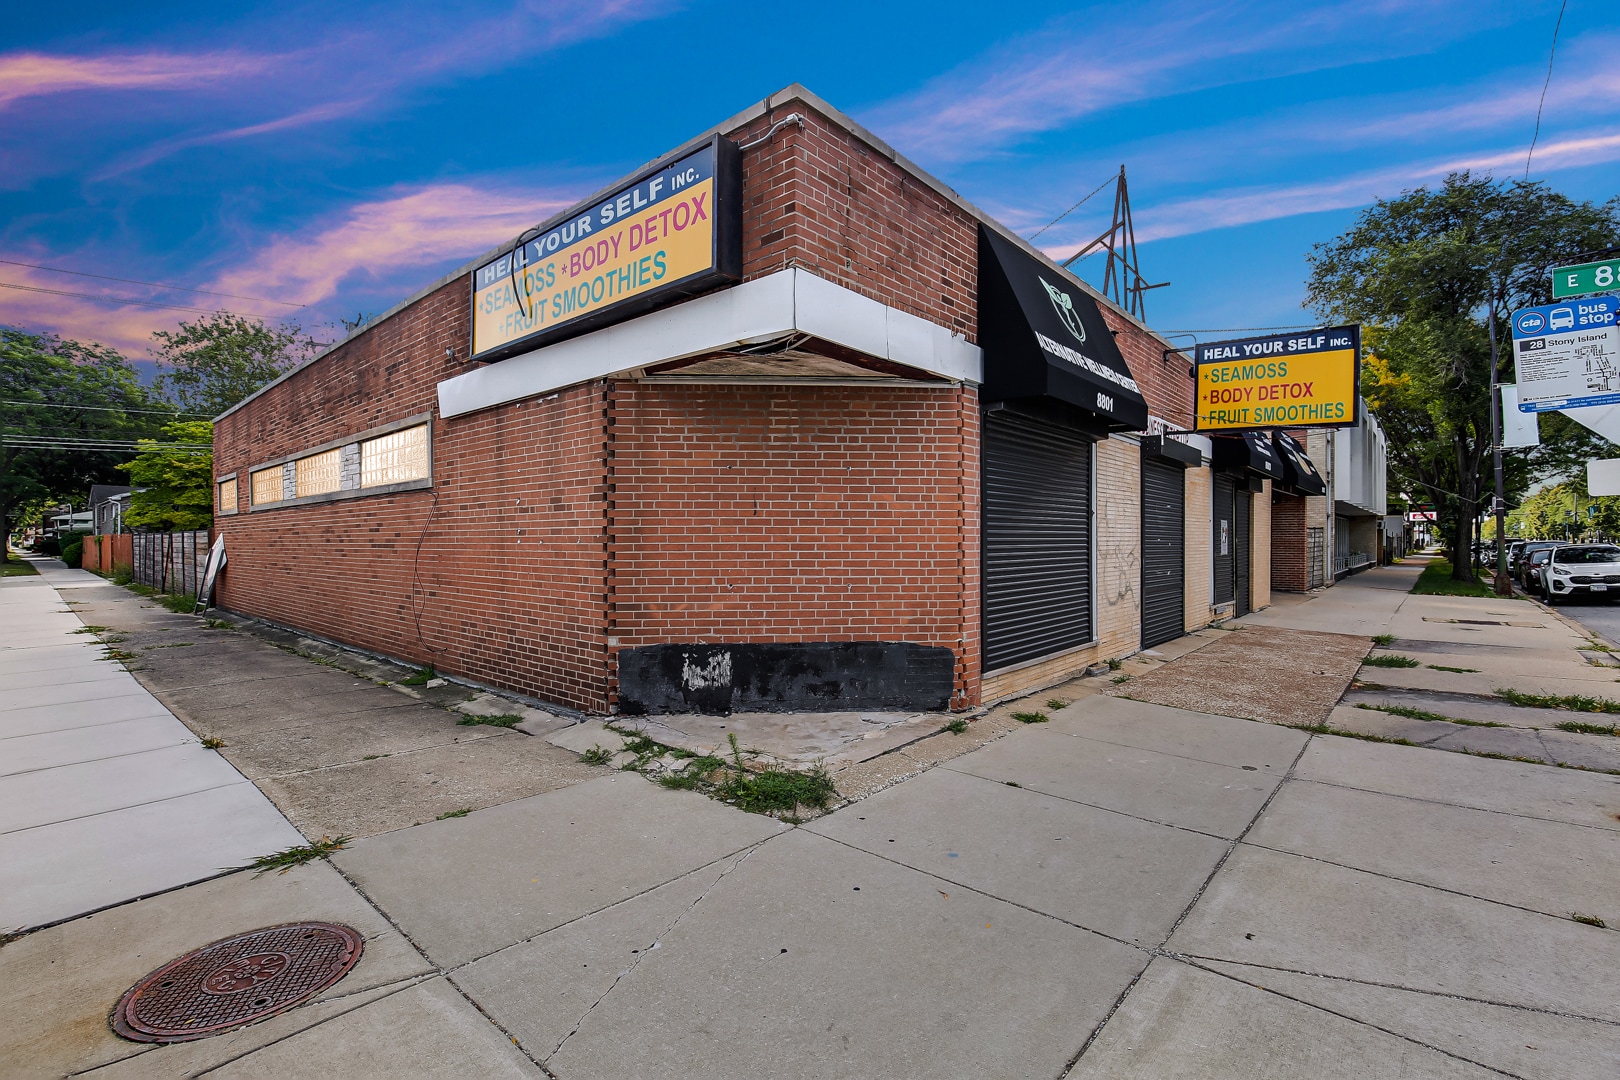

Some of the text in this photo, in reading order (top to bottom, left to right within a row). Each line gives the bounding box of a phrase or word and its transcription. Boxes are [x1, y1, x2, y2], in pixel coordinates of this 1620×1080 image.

[484, 167, 700, 284] HEAL YOUR SELF INC.
[485, 191, 708, 315] SEAMOSS BODY DETOX
[1567, 264, 1620, 288] E 8
[505, 250, 667, 338] FRUIT SMOOTHIES
[1578, 302, 1608, 315] bus
[1579, 311, 1615, 325] stop
[1521, 318, 1541, 329] cta
[1203, 336, 1352, 361] HEAL YOUR SELF INC.
[1529, 332, 1608, 350] 28 Stony Island
[1210, 361, 1288, 384] SEAMOSS
[1096, 392, 1114, 412] 8801
[1210, 381, 1314, 405] BODY DETOX
[1209, 401, 1345, 425] FRUIT SMOOTHIES
